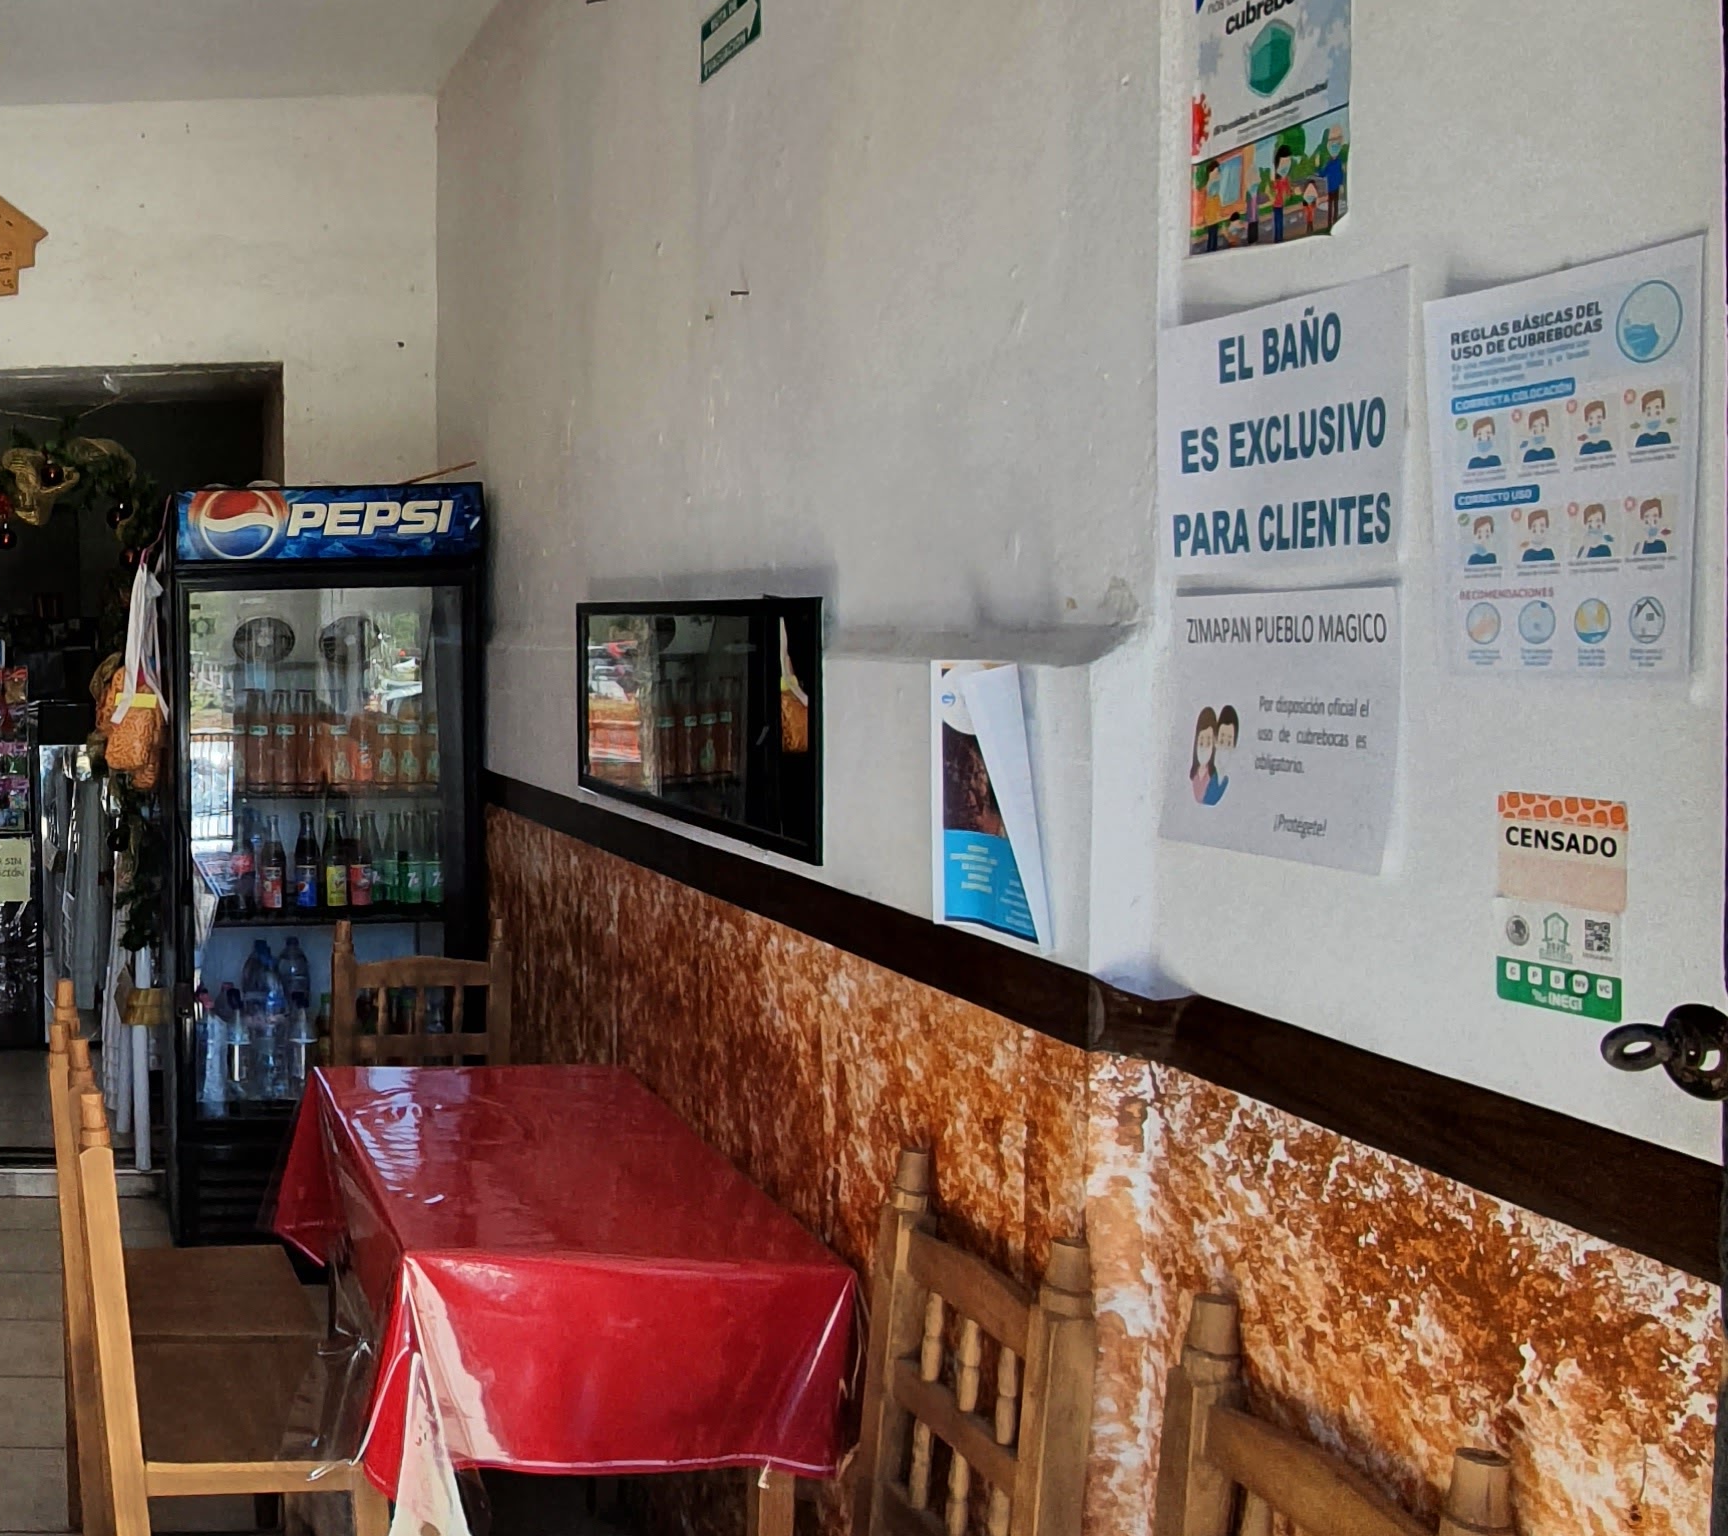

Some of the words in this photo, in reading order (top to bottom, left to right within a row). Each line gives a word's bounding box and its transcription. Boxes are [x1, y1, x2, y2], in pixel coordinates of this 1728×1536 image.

[1450, 321, 1510, 346] REGLAS
[1512, 306, 1574, 335] BÁSICAS
[1576, 300, 1603, 320] DEL
[1450, 342, 1483, 362] USO
[1486, 338, 1506, 356] DE
[1507, 318, 1604, 351] CUBREBOCAS
[1219, 335, 1254, 384] EL
[1262, 305, 1341, 376] BAÑO
[1180, 426, 1220, 475] ES
[1229, 396, 1386, 470] EXCLUSIVO
[286, 500, 454, 537] PEPSI
[1173, 508, 1250, 558] PARA
[1258, 492, 1391, 552] CLIENTES
[1186, 617, 1251, 644] ZIMAPAN
[1255, 614, 1314, 644] PUEBLO
[1318, 612, 1387, 644] MAGICO
[1259, 695, 1273, 712] Por
[1275, 695, 1325, 718] disposición
[1327, 697, 1358, 717] oficial
[1359, 698, 1370, 717] el
[1257, 728, 1273, 742] uso
[1278, 724, 1290, 743] de
[1295, 724, 1349, 748] cubrebocas
[1355, 733, 1367, 750] es
[1505, 825, 1618, 859] CENSADO
[4, 856, 22, 866] SIN
